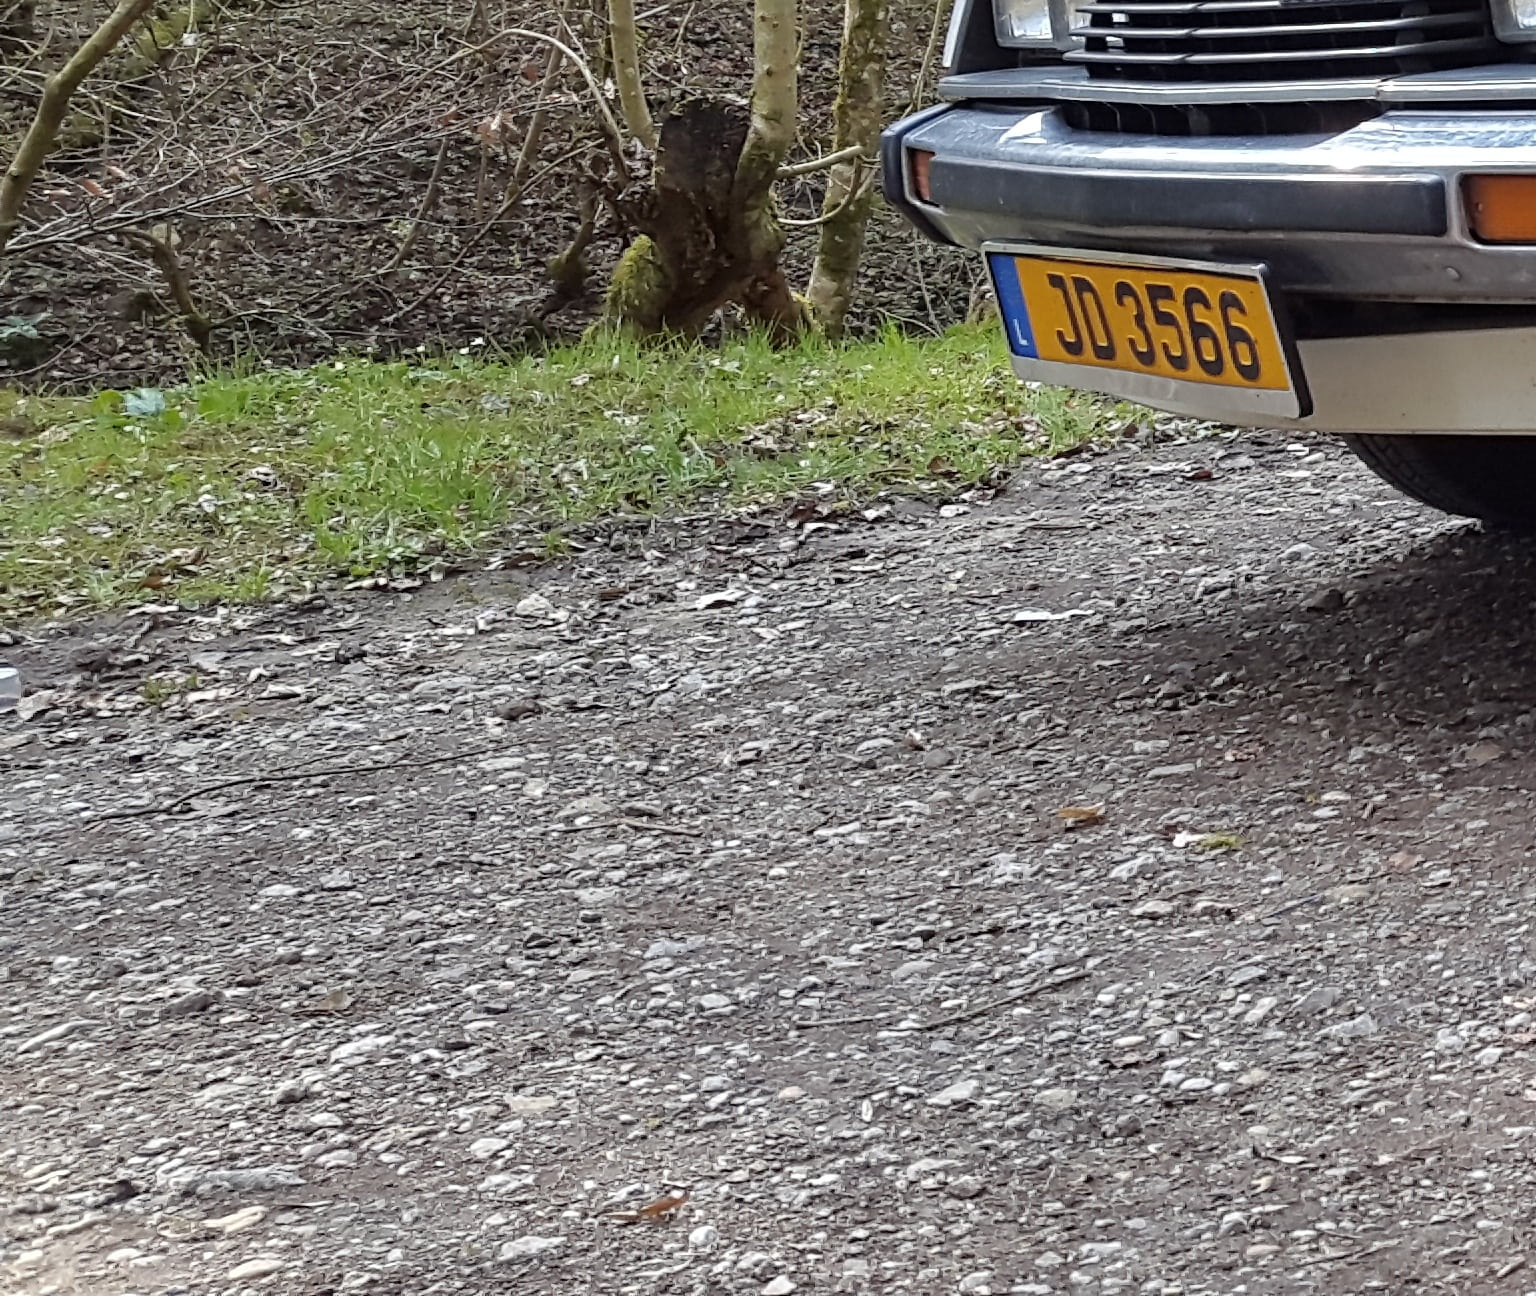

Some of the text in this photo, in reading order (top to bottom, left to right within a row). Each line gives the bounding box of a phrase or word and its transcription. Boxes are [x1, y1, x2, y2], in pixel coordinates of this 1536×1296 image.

[1012, 317, 1028, 346] L
[1047, 272, 1261, 381] JD 3566
